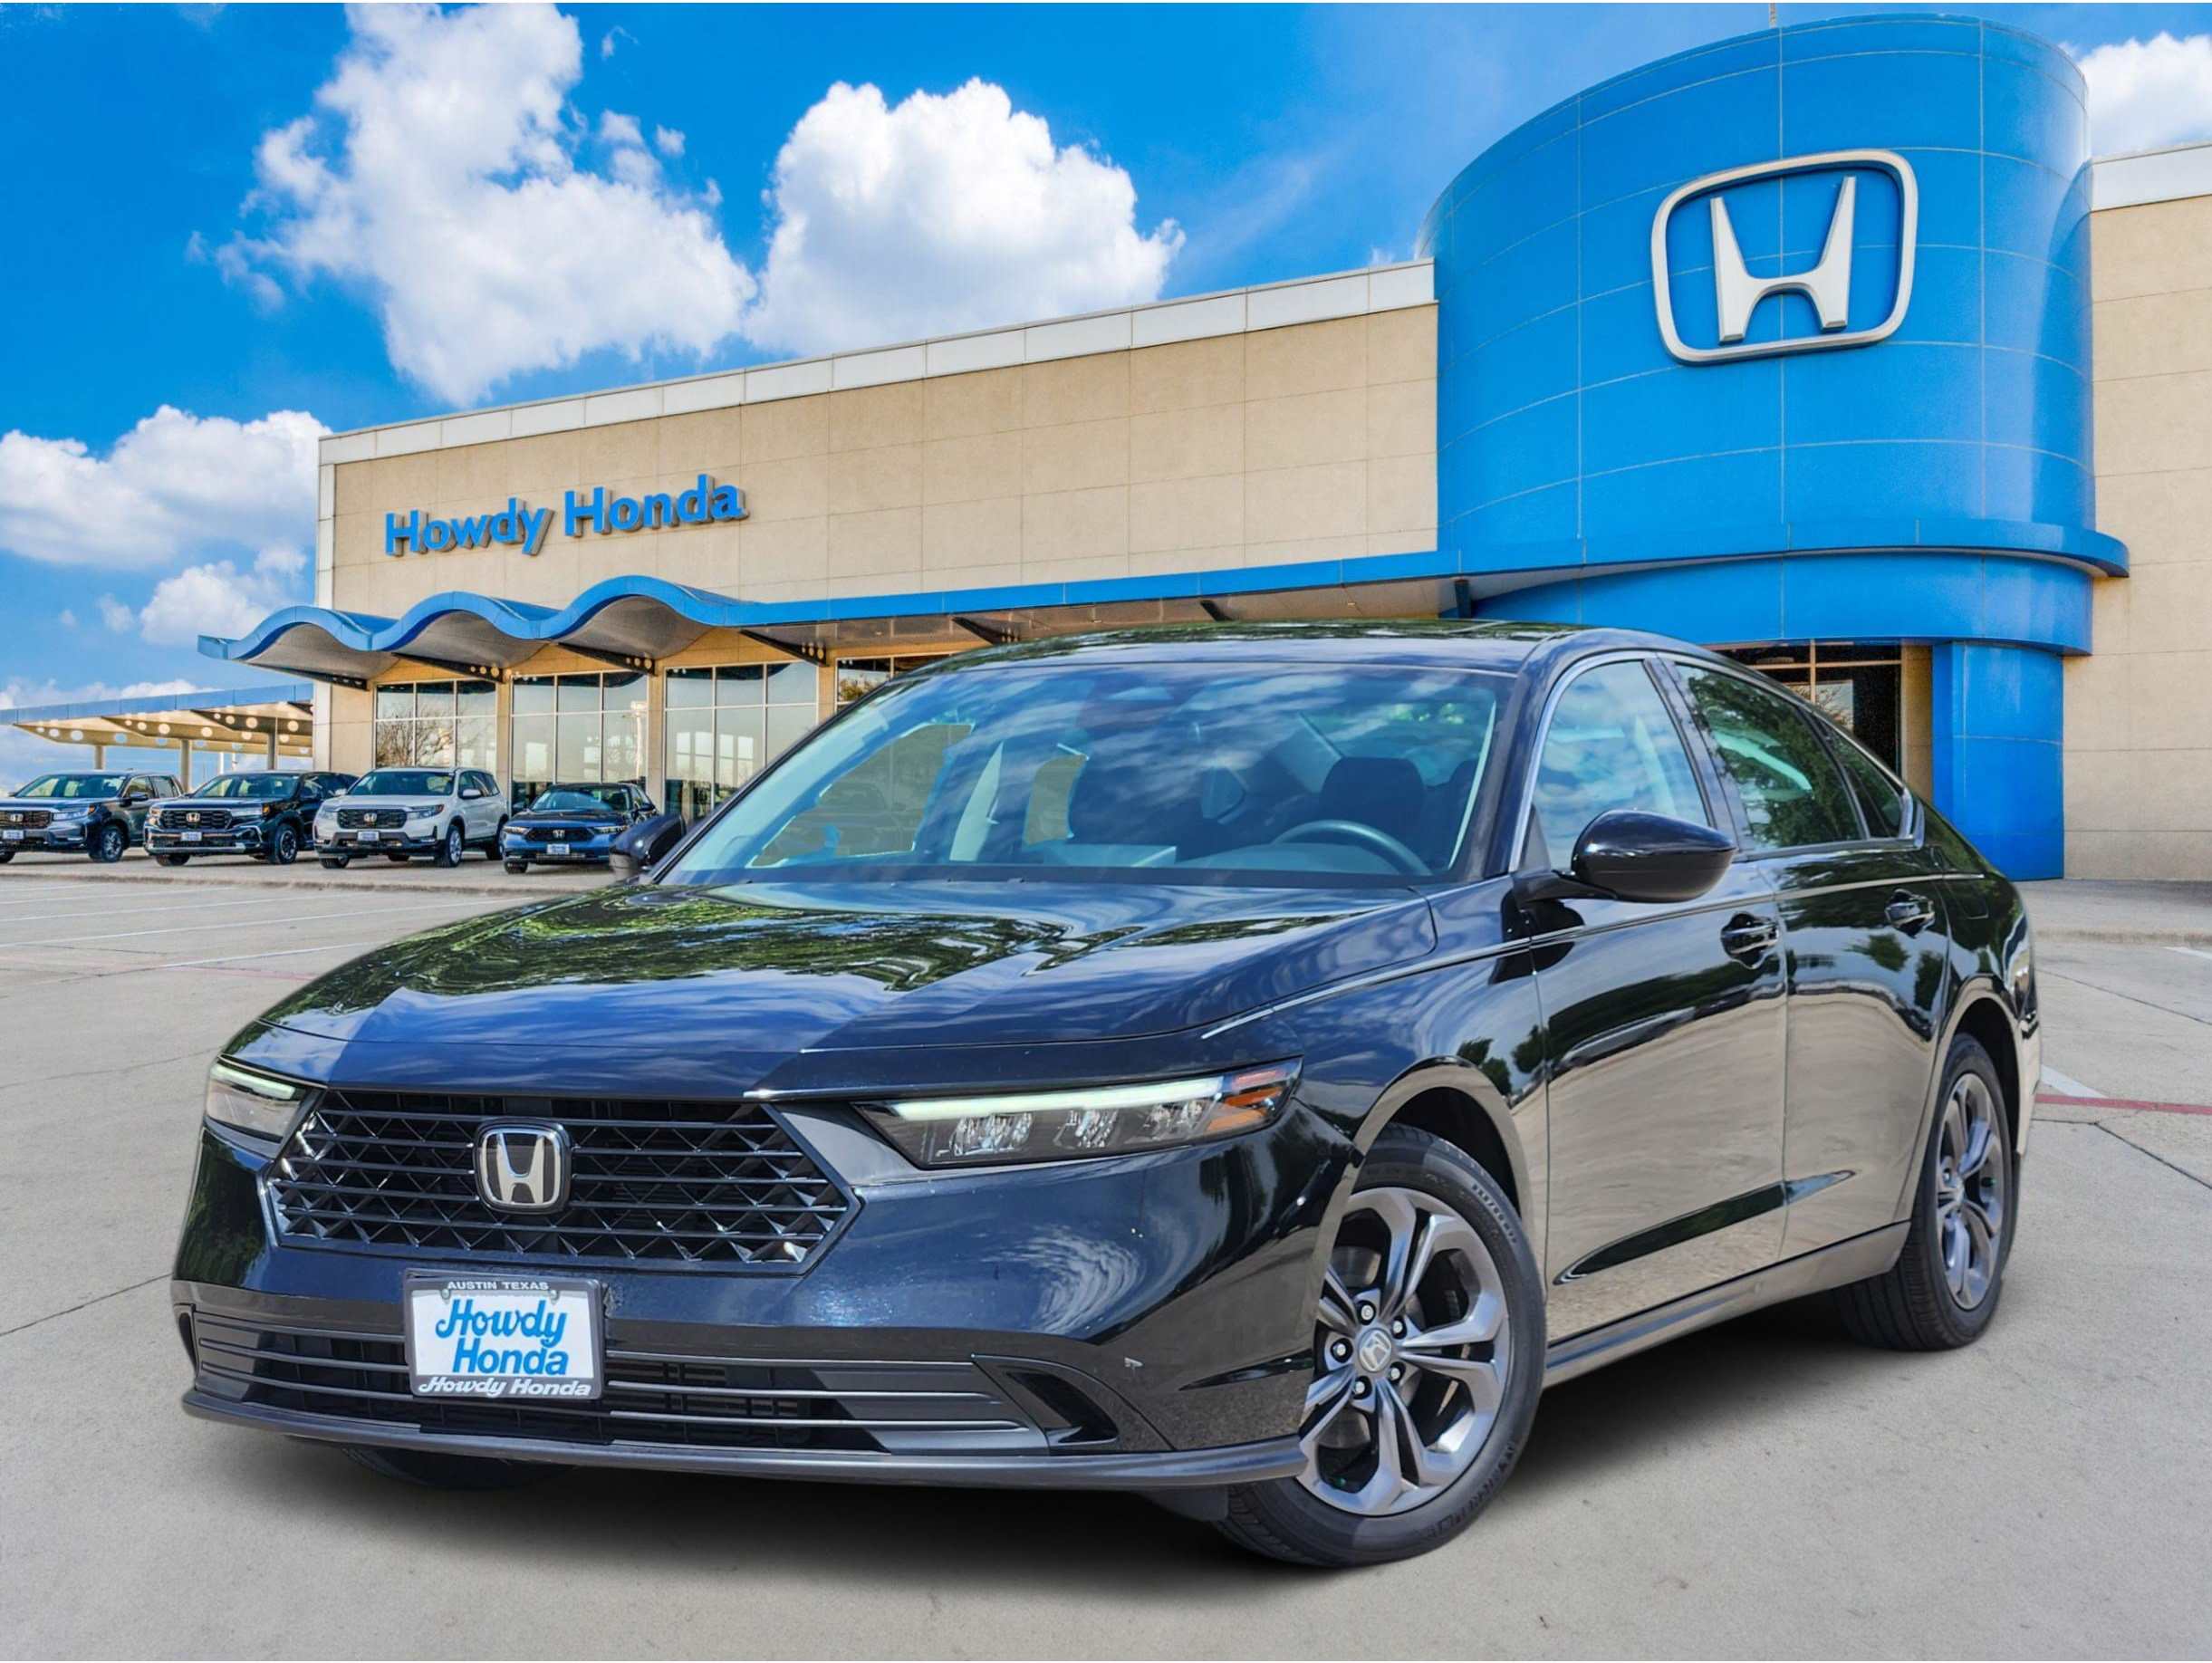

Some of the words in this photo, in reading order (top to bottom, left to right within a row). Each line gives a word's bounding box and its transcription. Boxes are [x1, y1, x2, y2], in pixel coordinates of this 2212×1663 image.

[385, 497, 555, 557] Howdy
[564, 474, 750, 539] Honda
[447, 1281, 497, 1291] AUSTIN
[501, 1281, 550, 1291] TEXAS
[435, 1299, 568, 1348] Howdy
[452, 1337, 570, 1376] Honda
[418, 1376, 507, 1398] Howdy
[509, 1378, 592, 1396] Honda
